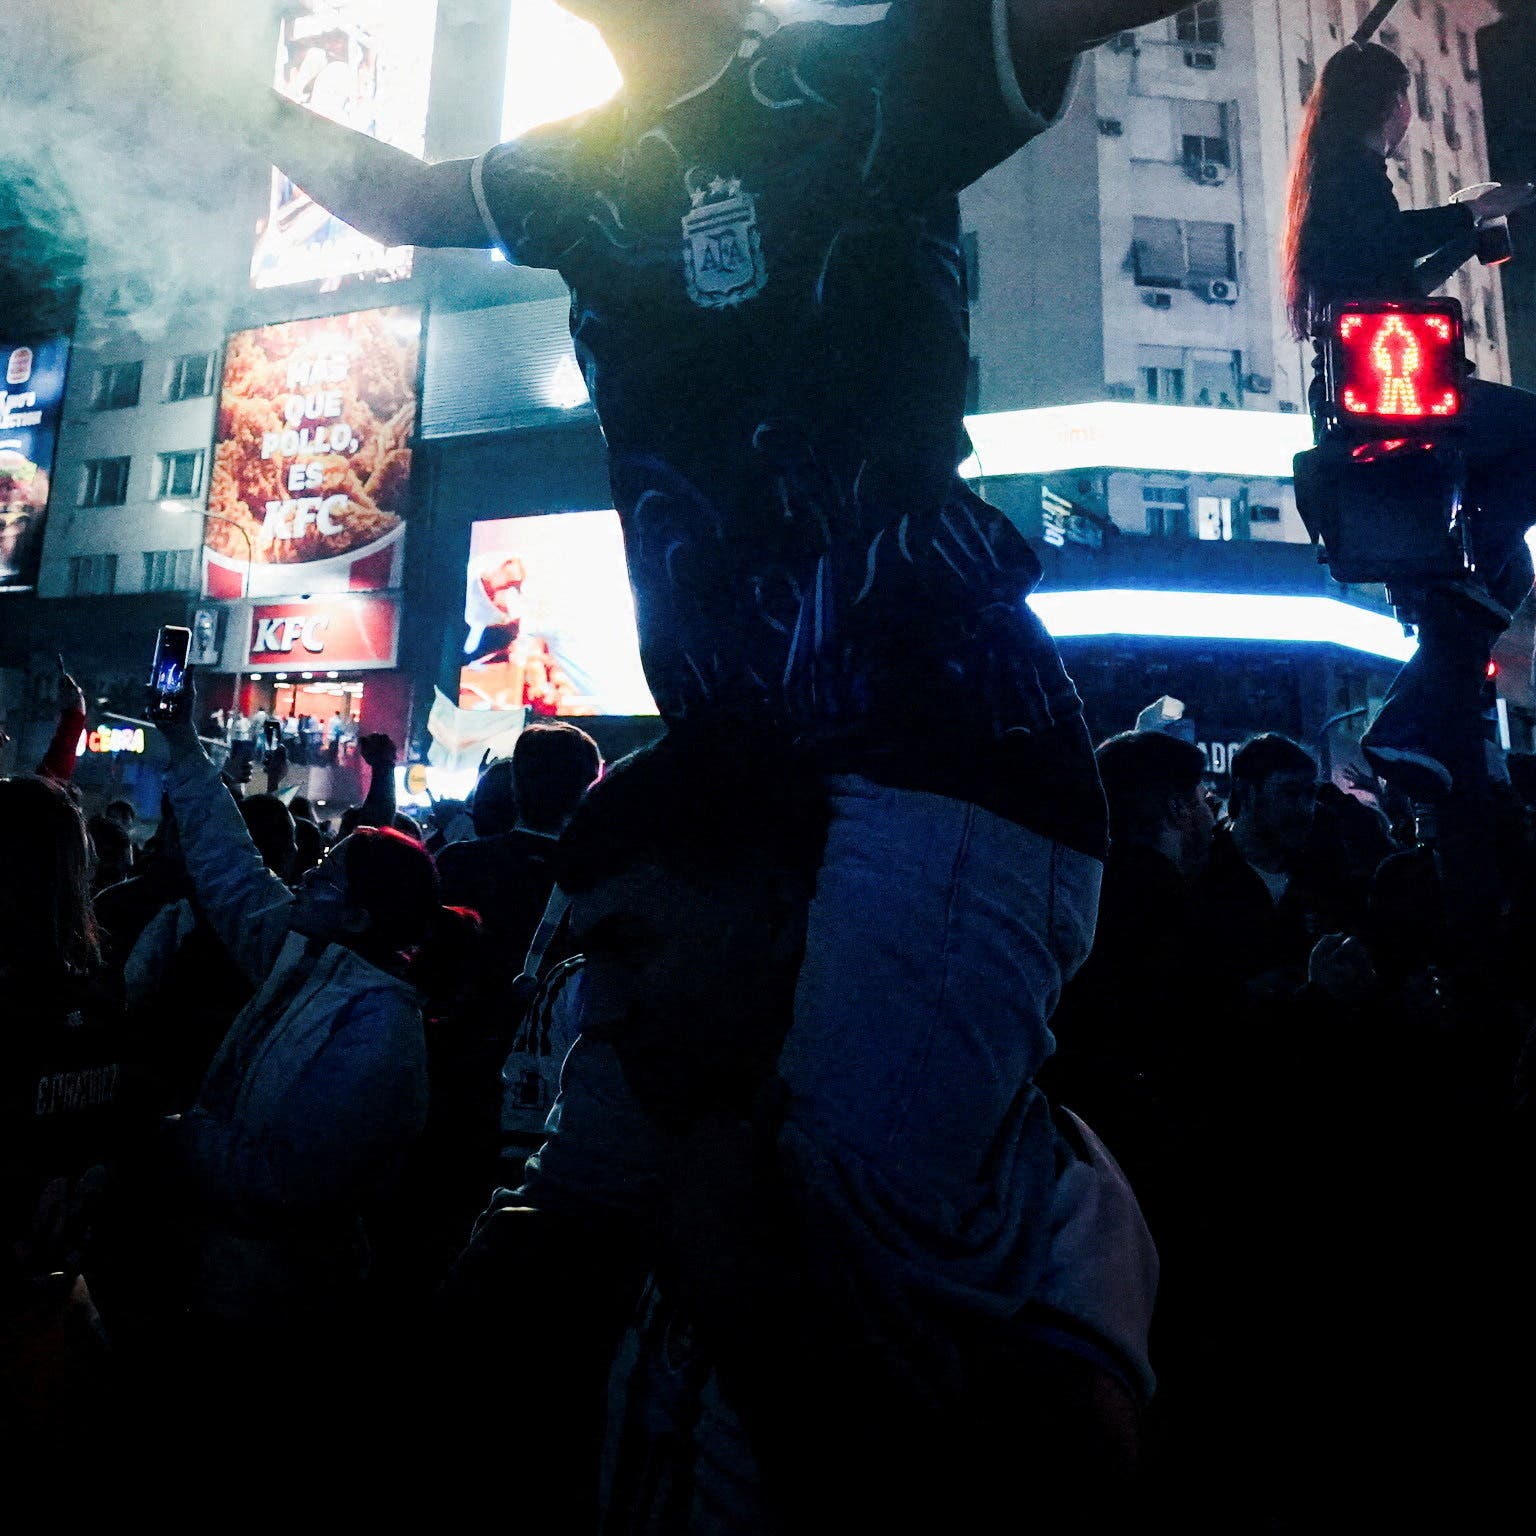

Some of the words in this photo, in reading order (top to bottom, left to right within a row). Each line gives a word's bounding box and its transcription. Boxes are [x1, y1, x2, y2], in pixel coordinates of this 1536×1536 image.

[284, 390, 343, 427] QUE
[261, 423, 359, 460] POLLO,
[288, 463, 325, 492] ES
[261, 493, 349, 542] KFC
[251, 612, 330, 655] KFC
